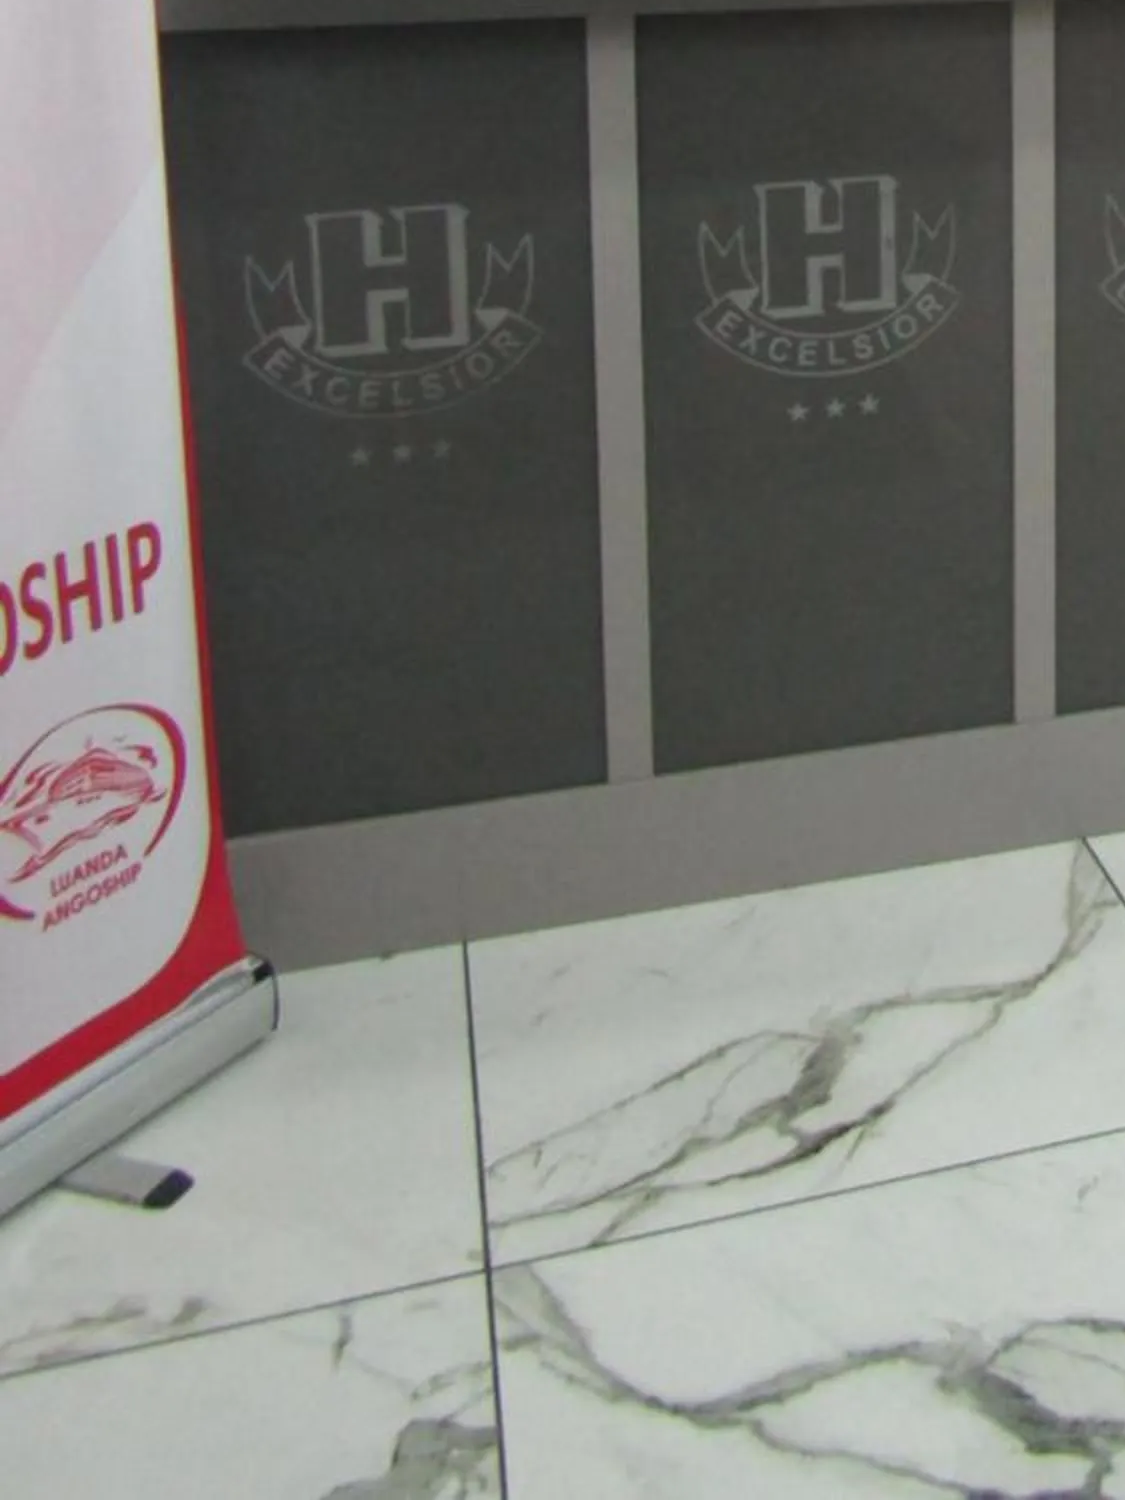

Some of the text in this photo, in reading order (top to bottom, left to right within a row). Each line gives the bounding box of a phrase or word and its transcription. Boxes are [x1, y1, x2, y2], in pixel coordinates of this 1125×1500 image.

[714, 292, 944, 367] EXCELSIOR
[263, 329, 523, 408] EXCELSIOR
[43, 862, 142, 932] ANGOSHIP
[51, 844, 128, 897] LUANDA
